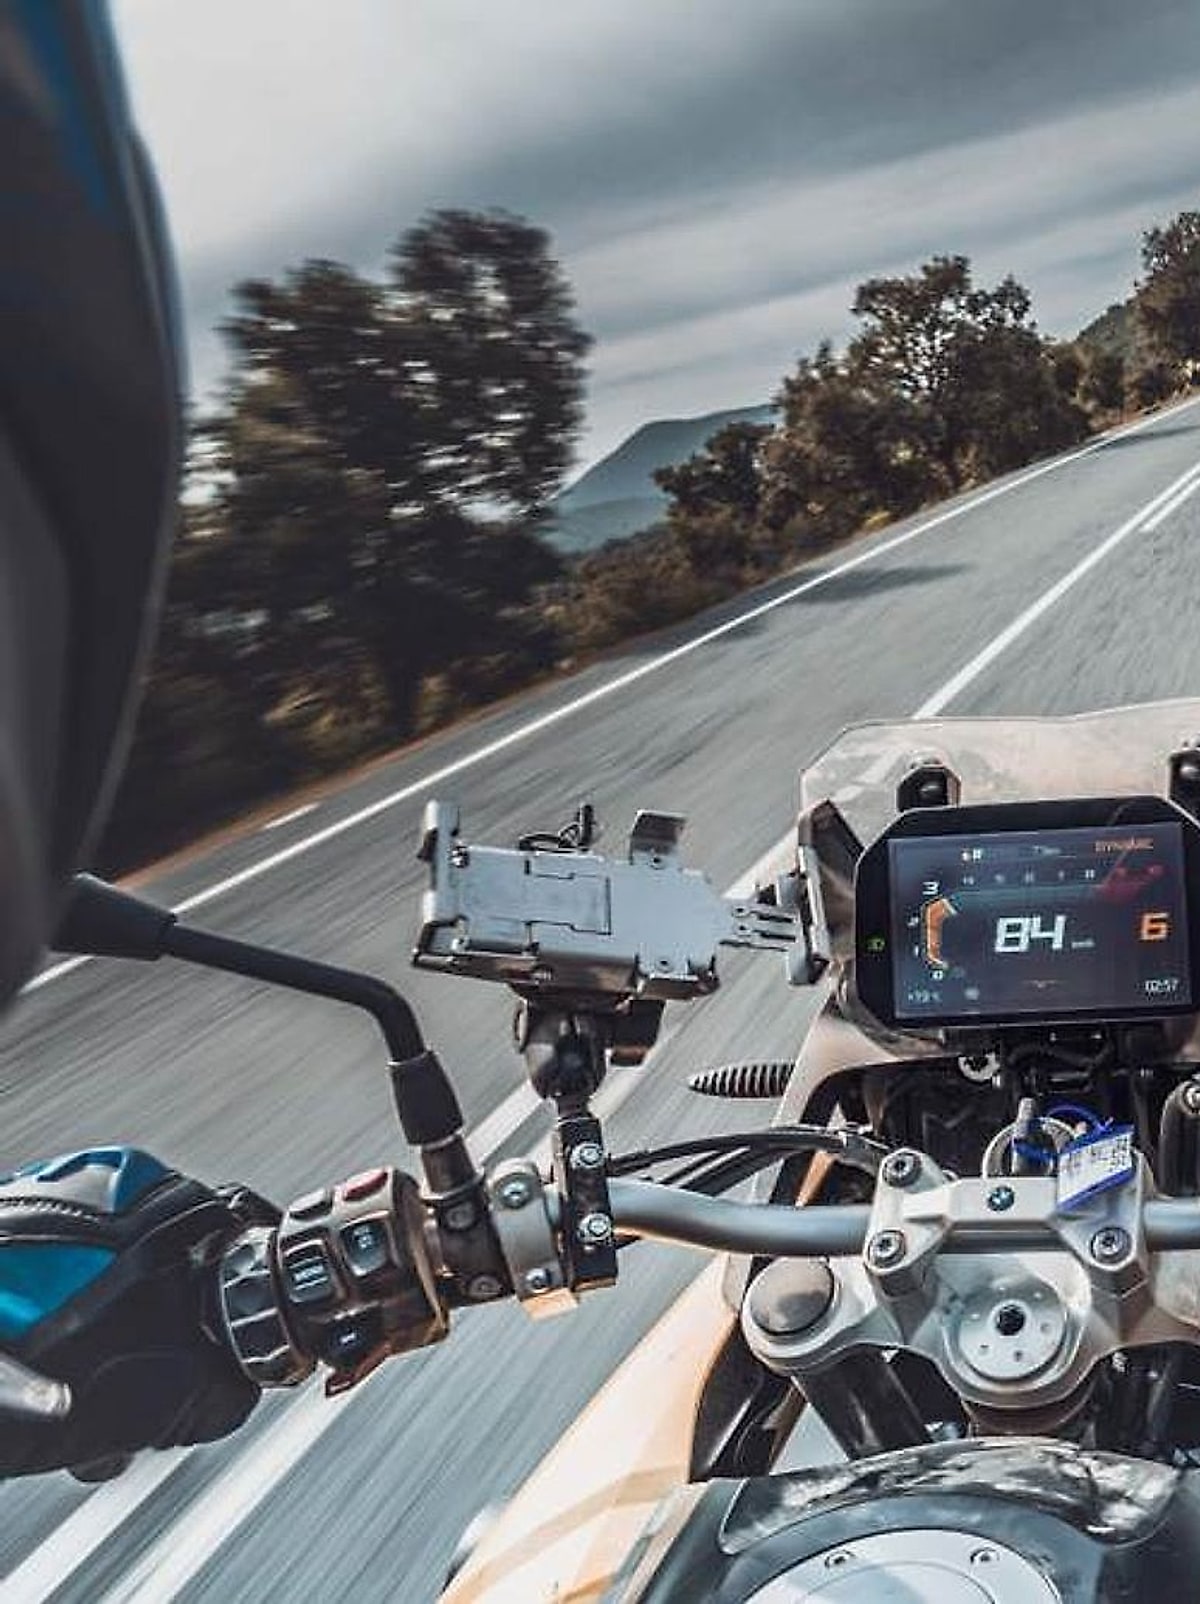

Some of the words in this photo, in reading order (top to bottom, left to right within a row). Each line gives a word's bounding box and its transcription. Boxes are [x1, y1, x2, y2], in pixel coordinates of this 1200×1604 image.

[923, 880, 940, 896] 3
[994, 914, 1067, 953] 84
[1139, 912, 1170, 941] 6
